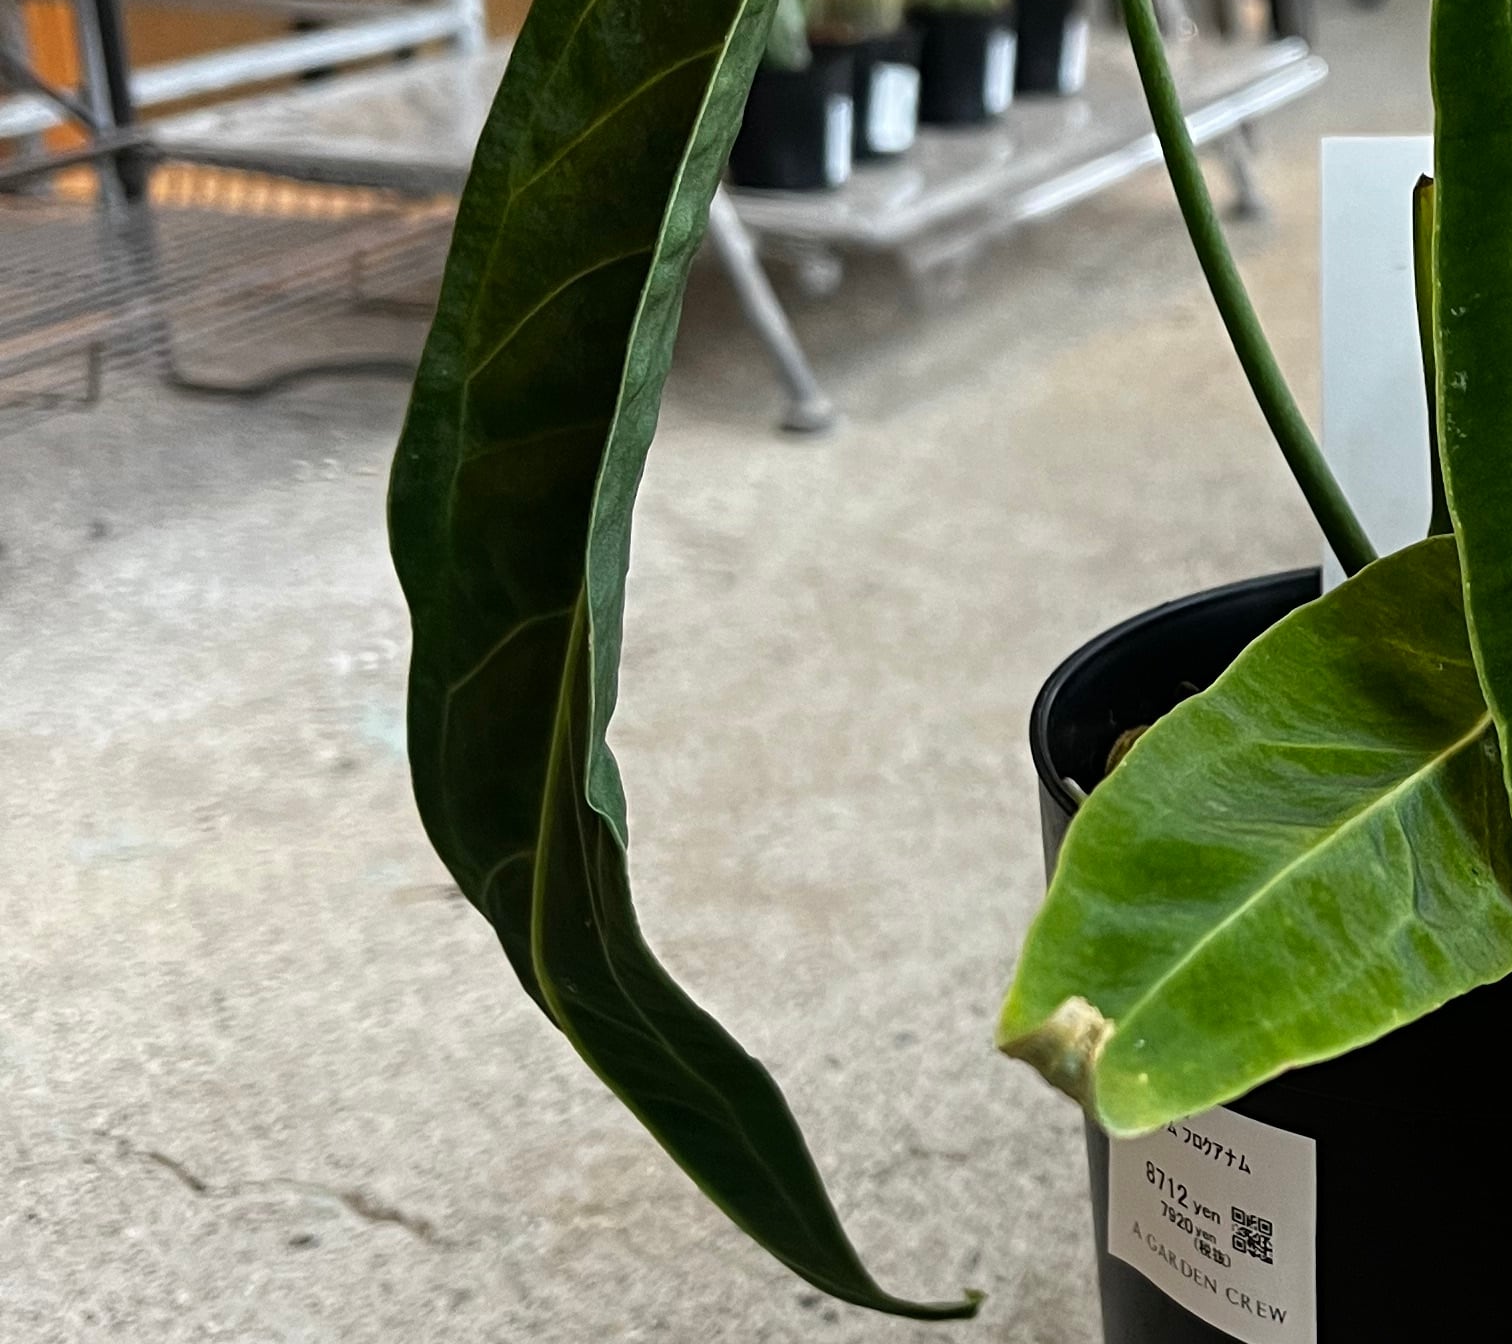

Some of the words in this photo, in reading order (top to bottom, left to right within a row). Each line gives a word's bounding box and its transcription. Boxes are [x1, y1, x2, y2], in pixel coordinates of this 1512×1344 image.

[1146, 1160, 1189, 1209] 8712
[1193, 1200, 1221, 1225] yen
[1161, 1200, 1194, 1235] 7920
[1195, 1226, 1217, 1245] yen
[1132, 1221, 1142, 1240] A
[1146, 1233, 1218, 1293] GARDEN
[1225, 1287, 1287, 1324] CREW
